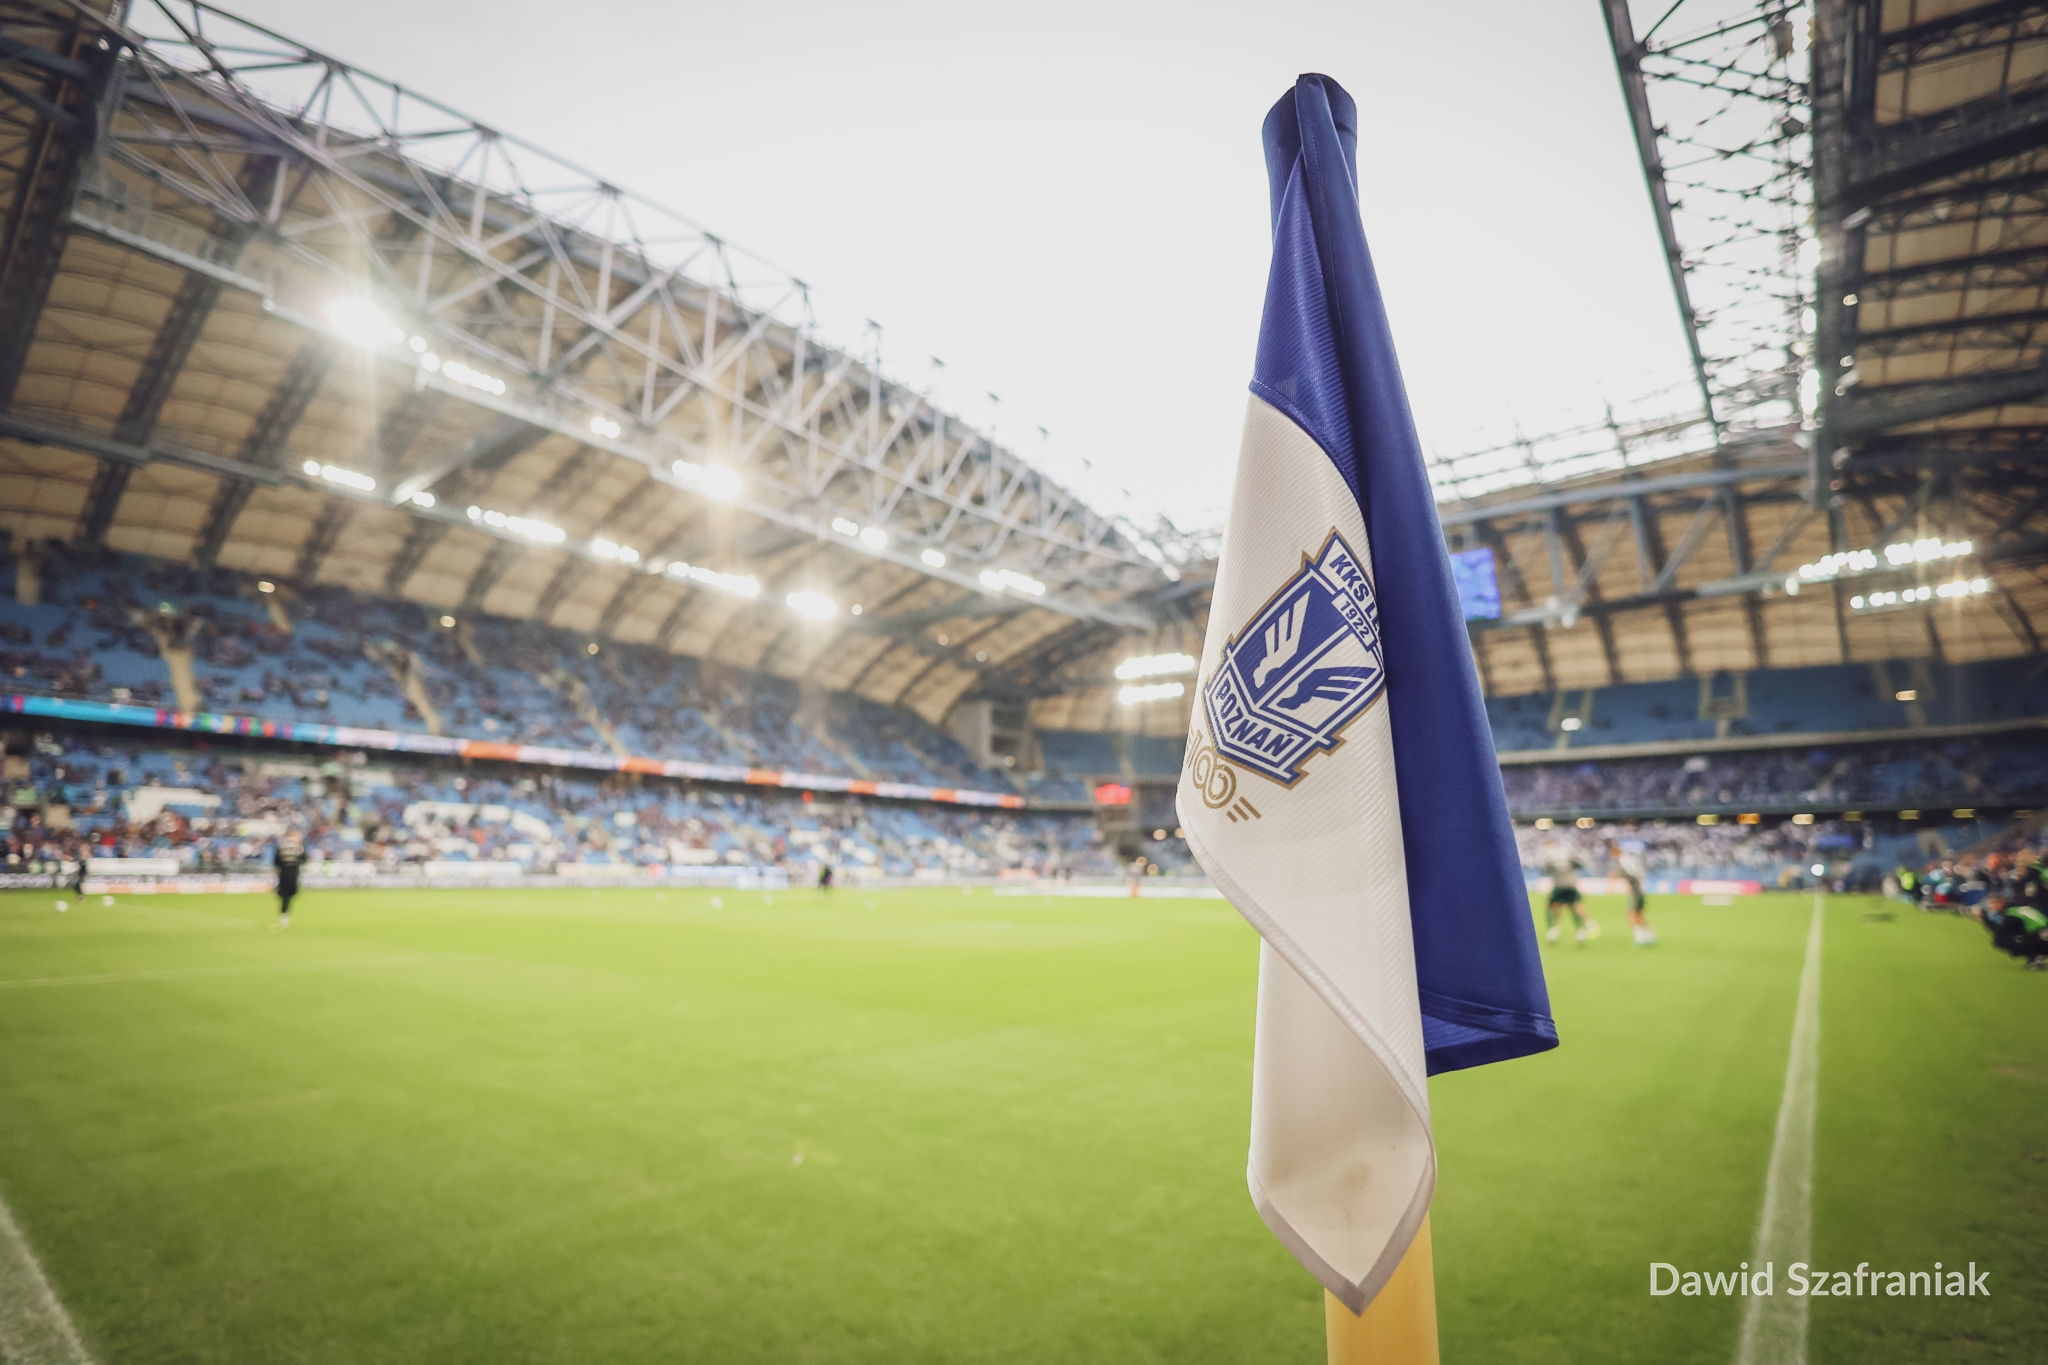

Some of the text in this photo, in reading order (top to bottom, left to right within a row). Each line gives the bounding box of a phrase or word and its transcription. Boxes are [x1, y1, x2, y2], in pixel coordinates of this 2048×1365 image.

[1329, 553, 1369, 602] KKS
[1340, 601, 1370, 638] 1922
[1216, 677, 1294, 757] POZNAŃ
